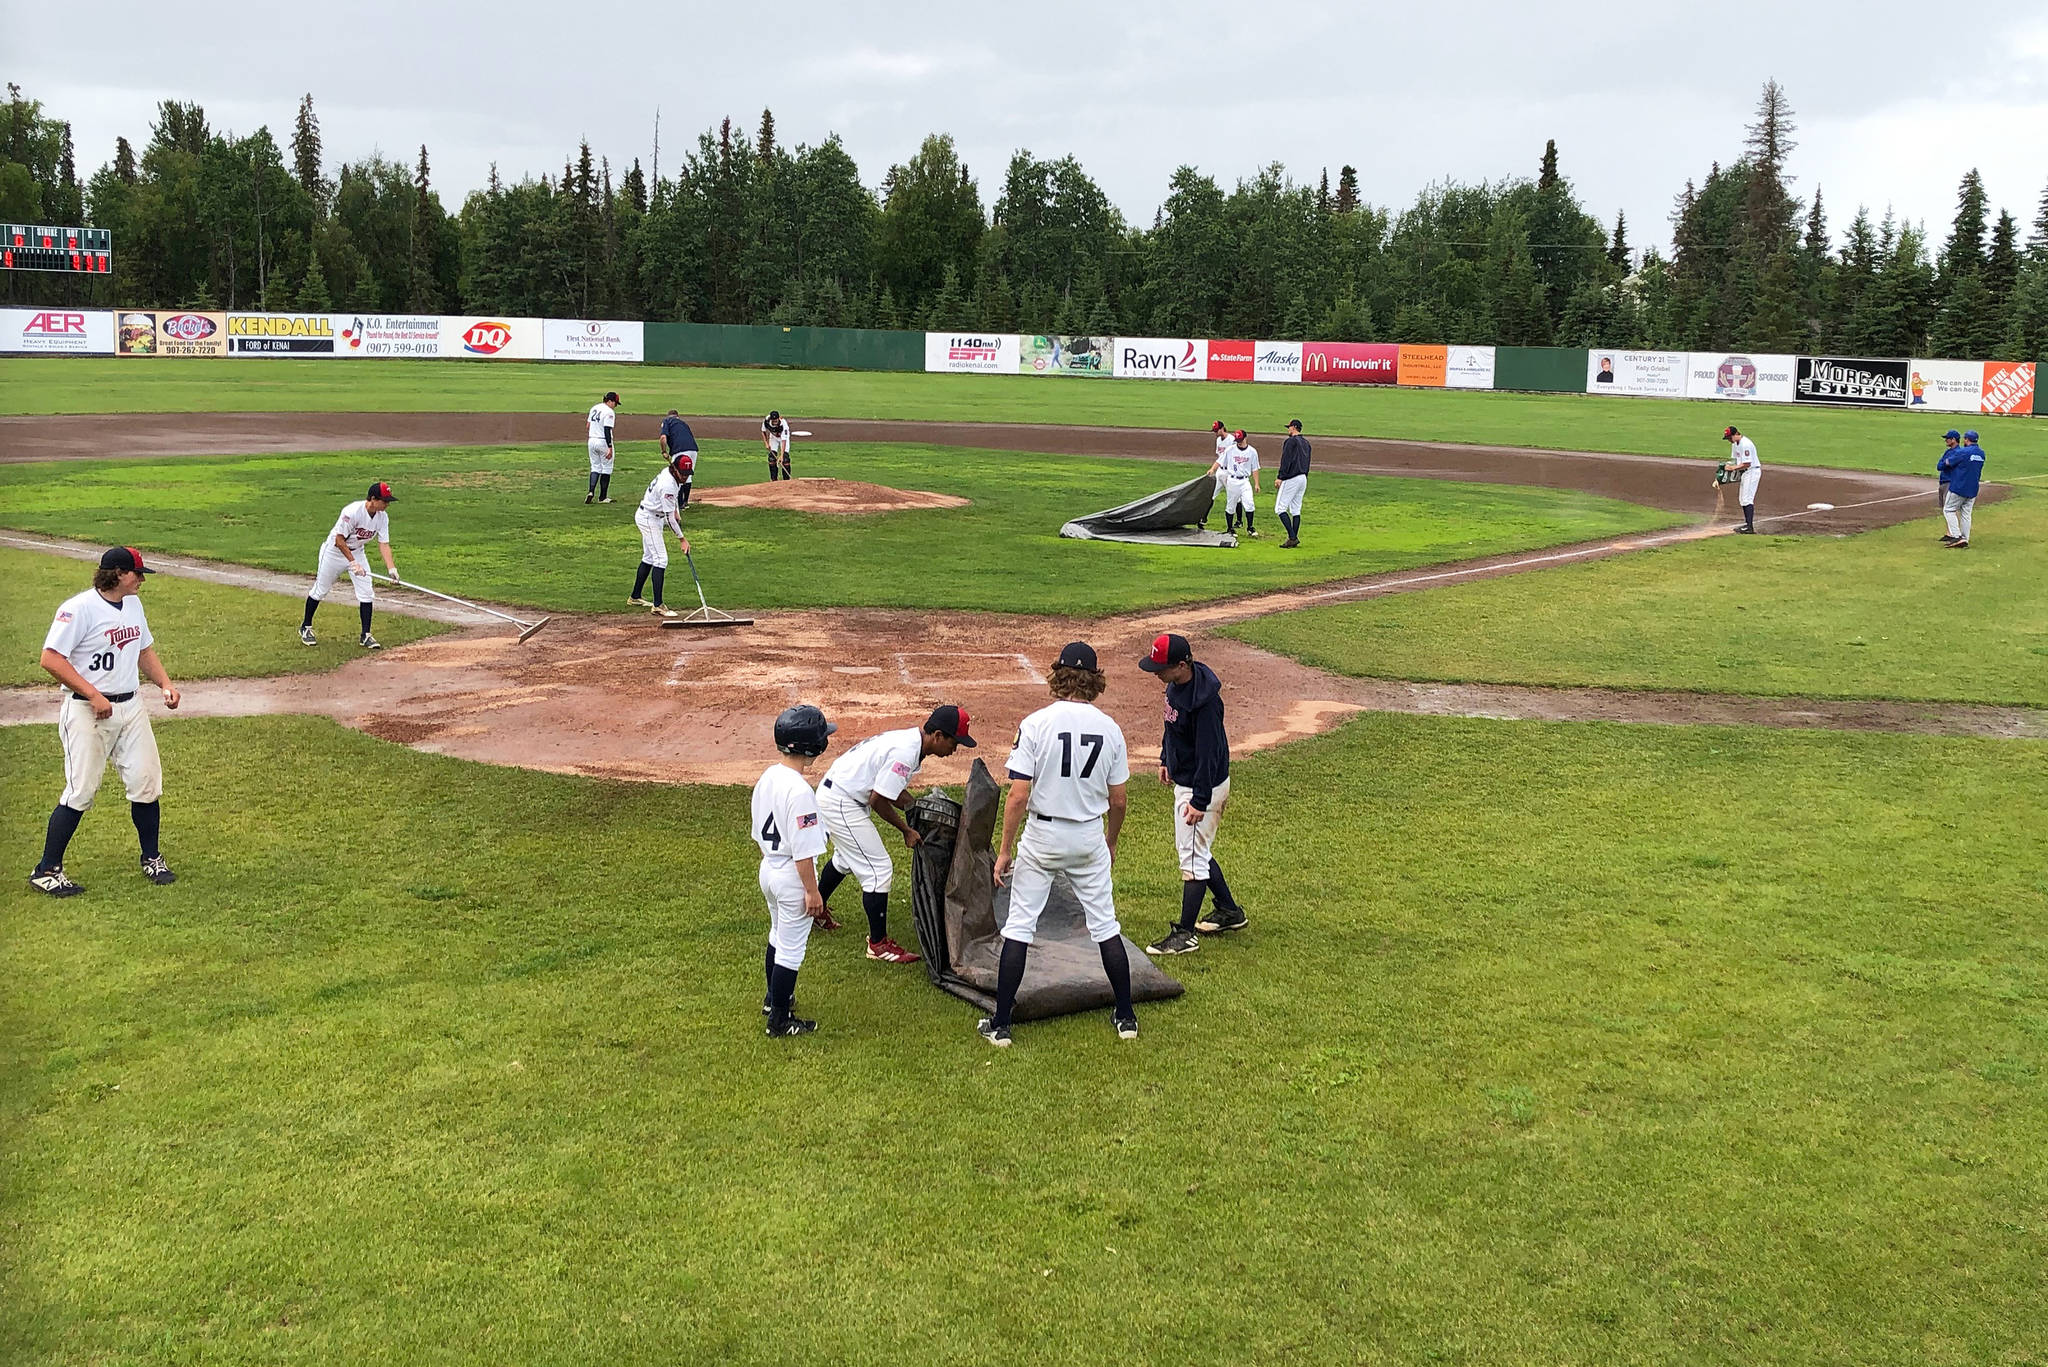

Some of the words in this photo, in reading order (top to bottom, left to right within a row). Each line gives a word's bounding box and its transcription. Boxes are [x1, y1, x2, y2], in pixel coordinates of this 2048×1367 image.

[24, 313, 87, 333] AER
[228, 316, 334, 336] KENDALL
[366, 318, 383, 330] K.O.
[386, 318, 439, 330] Entertainment
[470, 328, 506, 348] DQ
[581, 335, 605, 343] National
[950, 338, 982, 348] 1140
[166, 346, 216, 354] 907-262-7220
[245, 341, 262, 350] FORD
[263, 341, 271, 350] of
[272, 341, 290, 350] KENAI
[366, 342, 391, 354] (907)
[393, 343, 438, 354] 599-0103
[948, 348, 997, 361] ESPN
[1124, 348, 1176, 369] Ravn
[1257, 350, 1300, 366] Alaska
[1402, 353, 1445, 361] STEELHEAD
[1624, 355, 1657, 363] CENTURY
[949, 361, 998, 369] radiokenai.com
[1332, 357, 1350, 369] i'm
[1351, 358, 1381, 370] lovin'
[1382, 359, 1392, 371] it
[1694, 370, 1716, 380] PROUD
[1759, 373, 1789, 383] SPONSOR
[1809, 359, 1903, 390] MORGAN
[1987, 368, 2009, 388] THE
[1820, 382, 1887, 398] STEEL
[1981, 363, 2035, 412] HOME
[2000, 382, 2034, 413] DEPOT
[591, 409, 602, 423] 24
[684, 462, 691, 470] T
[104, 625, 141, 647] Twins
[88, 651, 115, 671] 30
[1058, 732, 1104, 779] 17
[761, 811, 782, 851] 4
